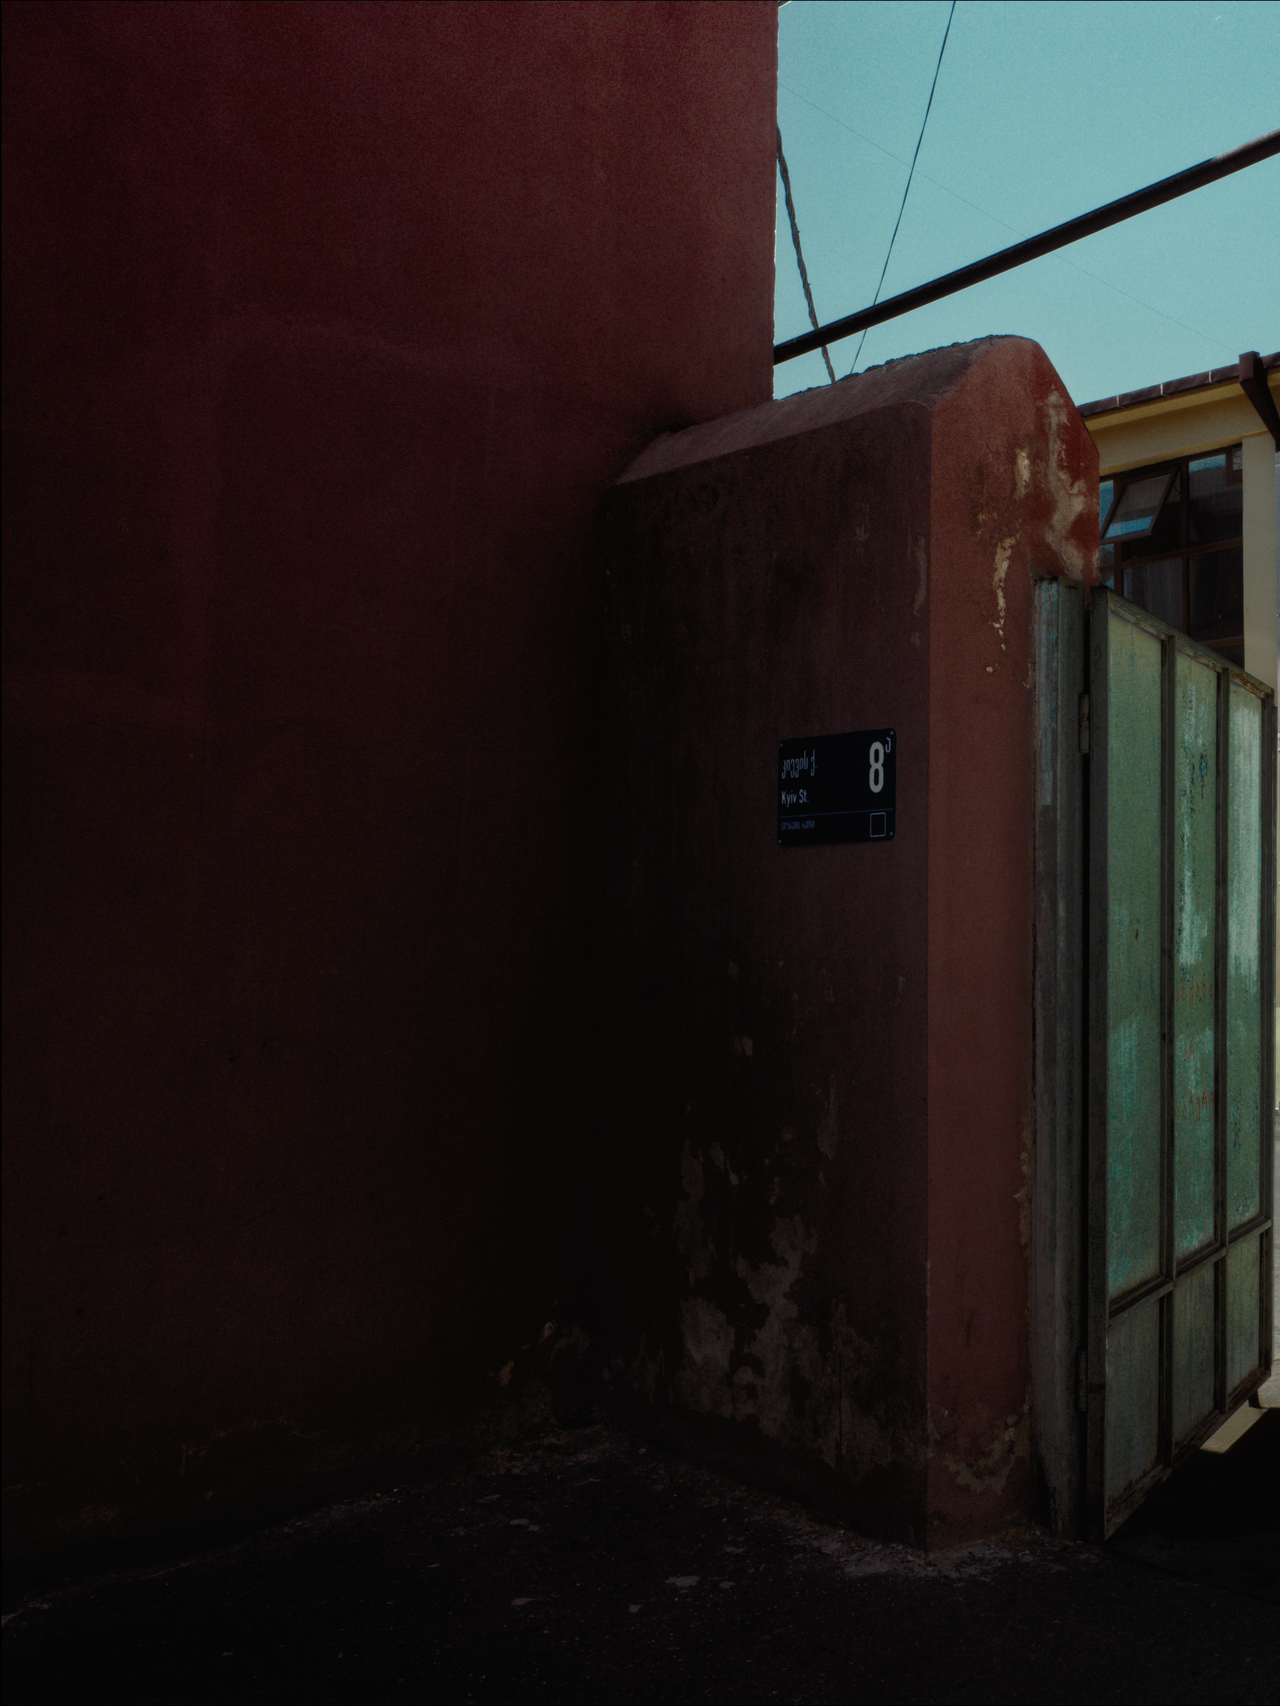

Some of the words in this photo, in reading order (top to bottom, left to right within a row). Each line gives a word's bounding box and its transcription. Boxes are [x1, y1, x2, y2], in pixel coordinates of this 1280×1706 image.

[781, 750, 809, 779] კიევის
[810, 749, 818, 777] ქ.
[781, 789, 798, 808] Kyiv
[799, 788, 810, 804] St.
[1175, 973, 1214, 1007] ანქანა
